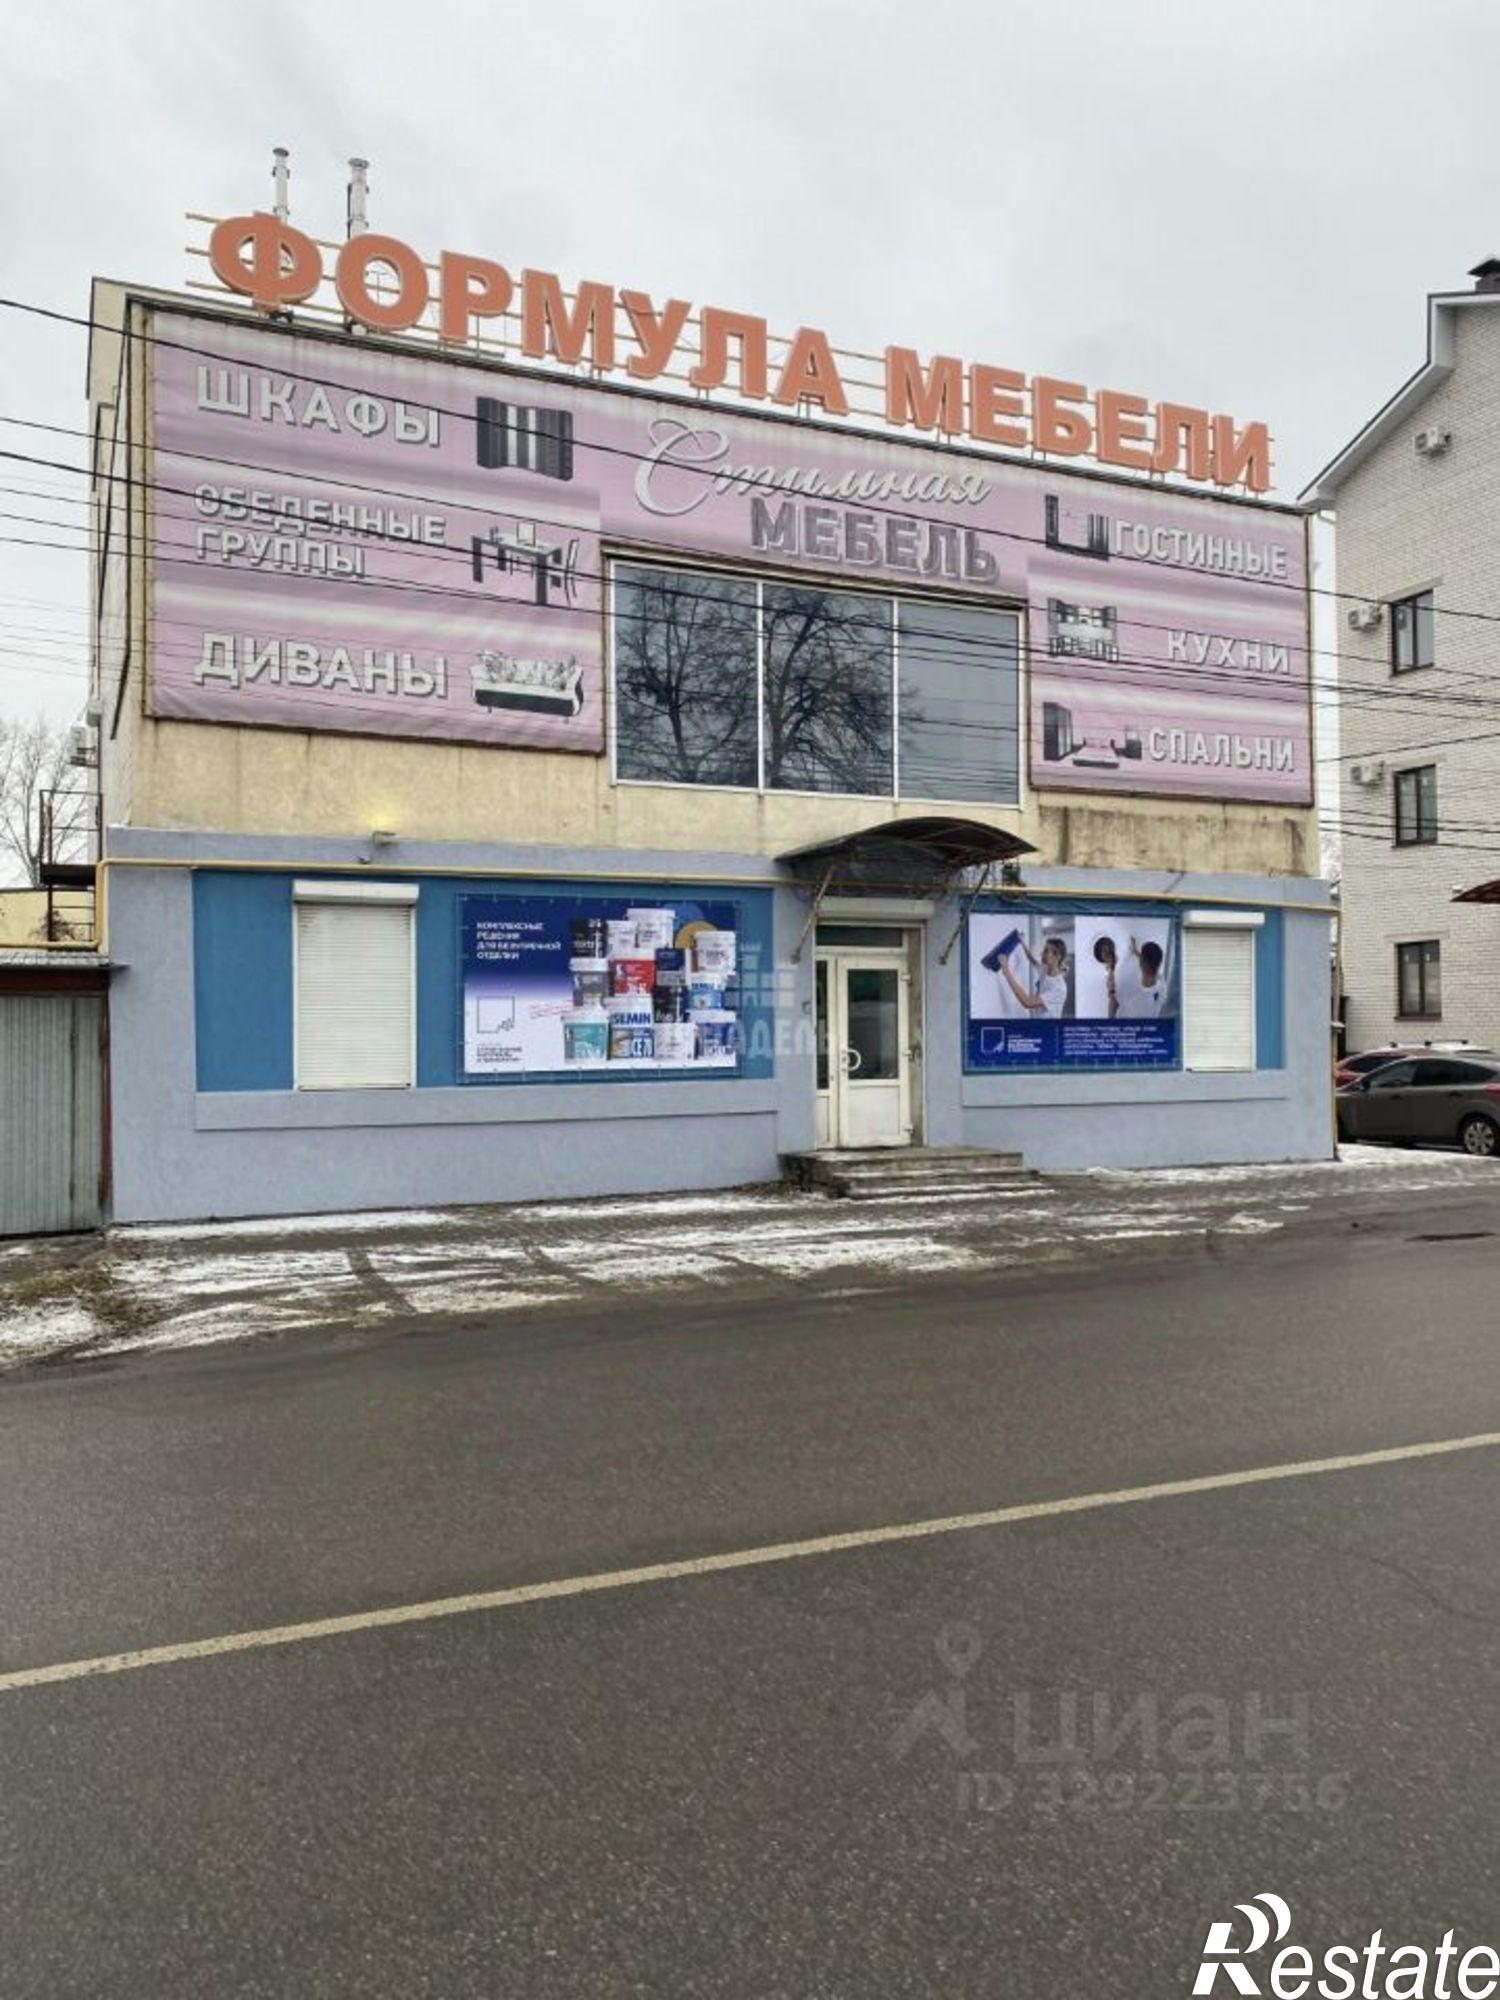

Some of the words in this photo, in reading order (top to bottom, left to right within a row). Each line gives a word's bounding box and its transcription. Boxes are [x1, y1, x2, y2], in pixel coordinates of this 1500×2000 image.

[208, 212, 849, 416] ФОРМУЛА
[885, 345, 1270, 492] МЕБЕЛИ
[196, 366, 441, 448] ШКАФЫ
[195, 483, 447, 546] ОБЕДЕННЫЕ
[750, 497, 997, 584] МЕБЕЛЬ
[196, 525, 366, 579] ГРУППЫ
[1114, 519, 1289, 579] ГОСТИННЫЕ
[194, 632, 449, 699] ДИВАНЫ
[1167, 630, 1290, 674] КУХНИ
[1150, 726, 1296, 773] СПАЛЬНИ
